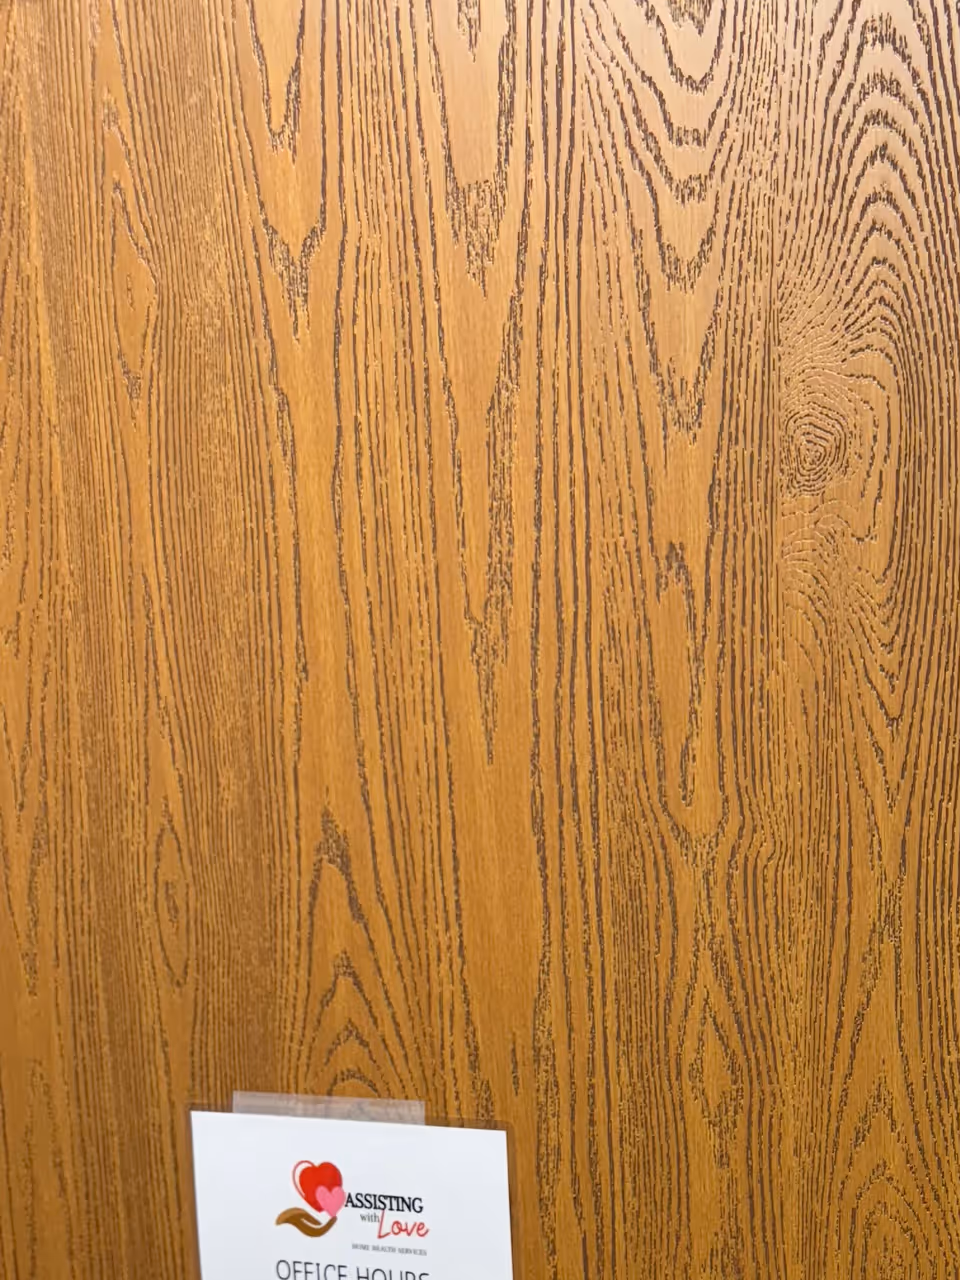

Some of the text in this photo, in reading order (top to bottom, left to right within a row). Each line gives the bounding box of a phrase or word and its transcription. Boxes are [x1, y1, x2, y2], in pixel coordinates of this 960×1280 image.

[344, 1192, 424, 1213] ASSISTING
[360, 1209, 430, 1239] with Love
